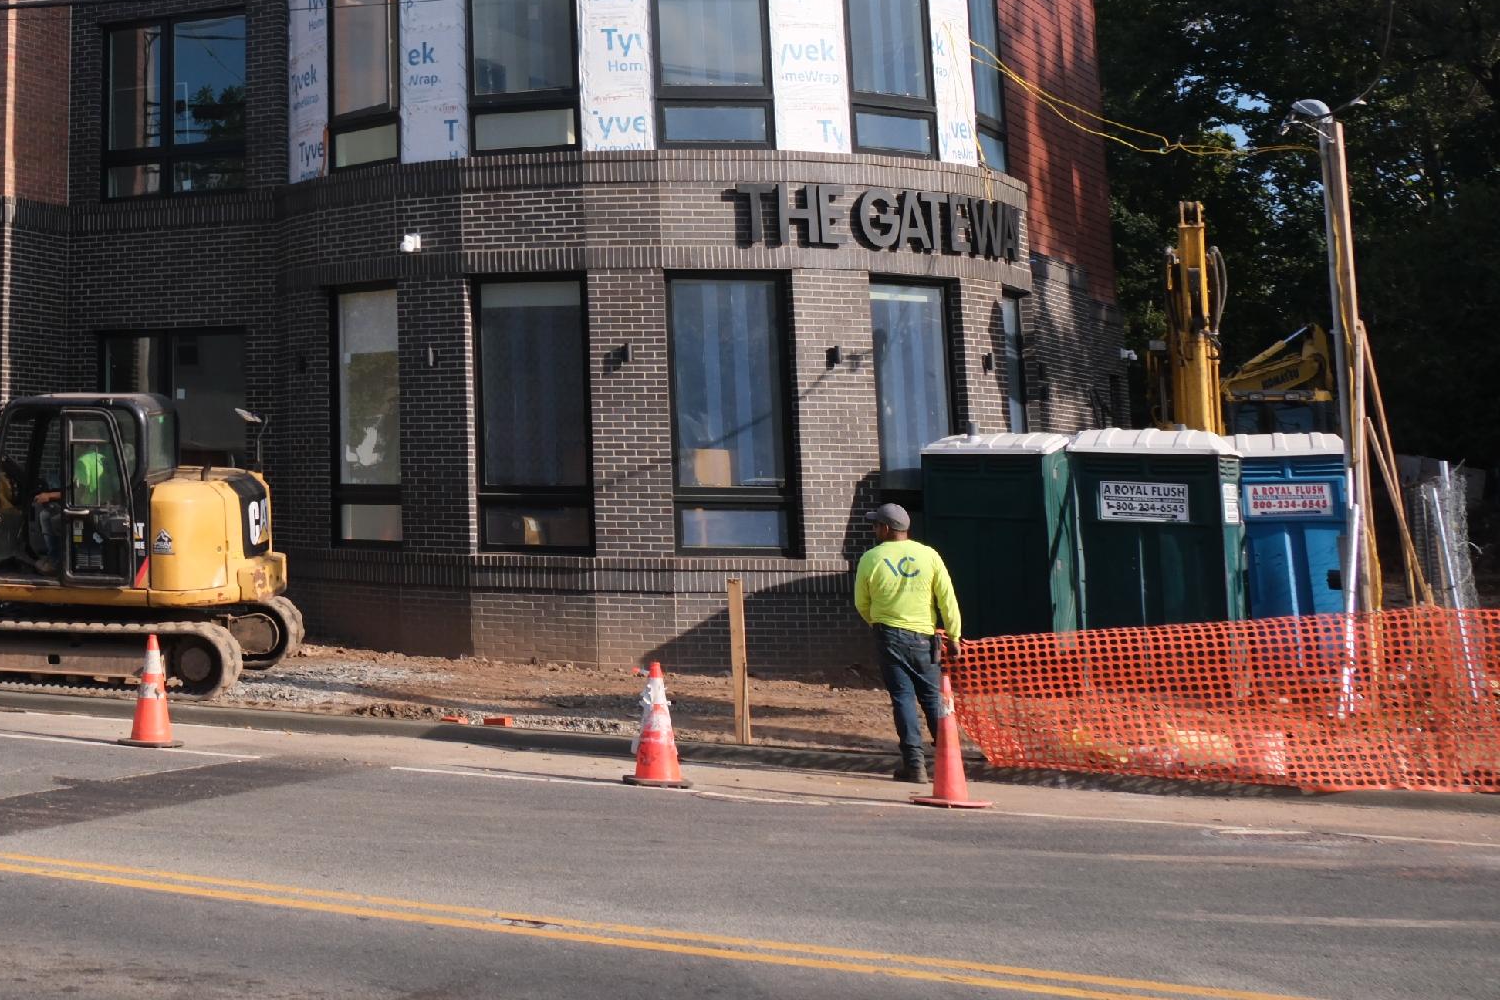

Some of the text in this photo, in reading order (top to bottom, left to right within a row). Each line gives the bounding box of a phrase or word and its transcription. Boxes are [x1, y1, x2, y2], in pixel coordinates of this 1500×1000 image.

[408, 41, 434, 67] ek
[443, 119, 459, 142] T
[736, 184, 846, 244] THE
[1104, 485, 1185, 497] A ROYAL FLUSH
[1252, 486, 1324, 495] A ROYAL FLUSH
[1106, 501, 1185, 513] 1-800-234-6545
